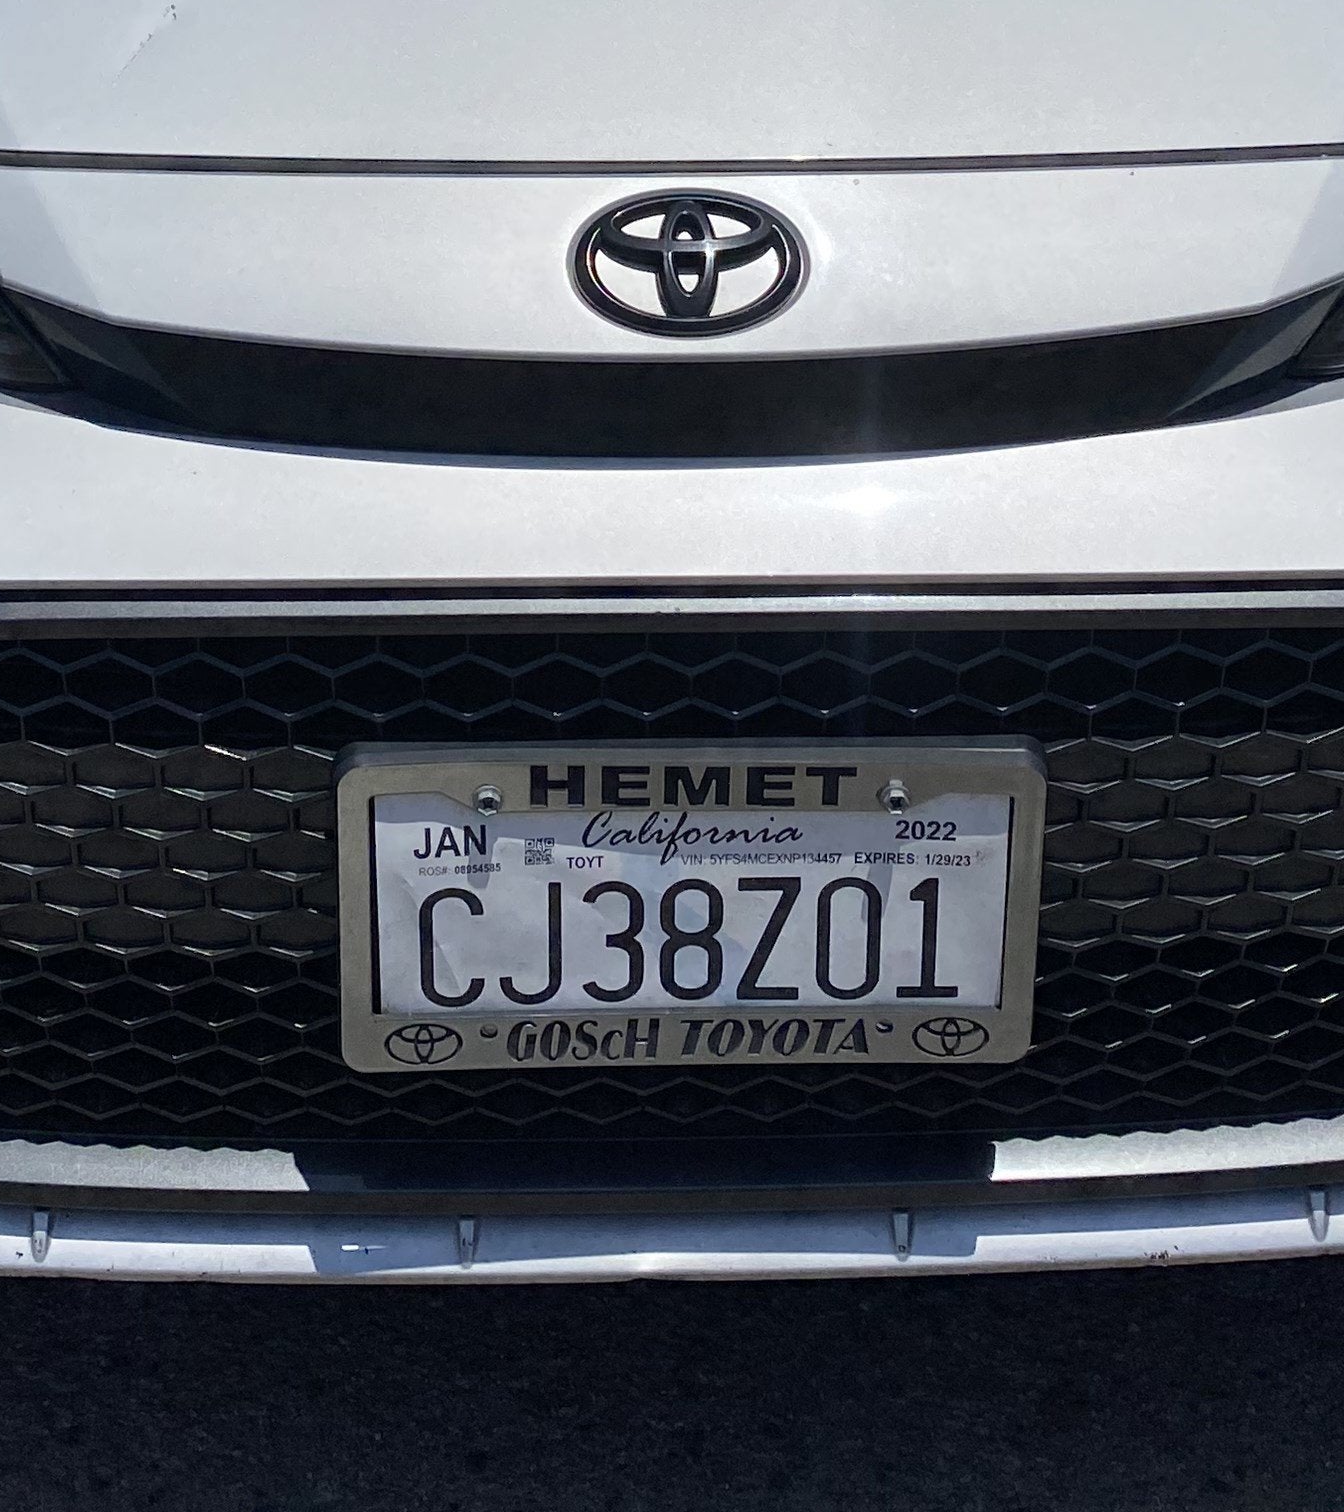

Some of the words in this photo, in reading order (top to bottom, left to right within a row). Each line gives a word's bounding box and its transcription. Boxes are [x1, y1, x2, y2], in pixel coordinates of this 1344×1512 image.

[530, 765, 858, 807] HEMET
[413, 824, 487, 859] JAN
[581, 811, 804, 866] California
[895, 820, 957, 842] 2022
[566, 855, 605, 869] TOYT
[681, 854, 705, 865] VIN:
[854, 851, 918, 865] EXPIRES:
[925, 854, 972, 866] 1/29/23
[419, 877, 959, 1008] CJ38Z01
[679, 1017, 869, 1056] TOYOTA
